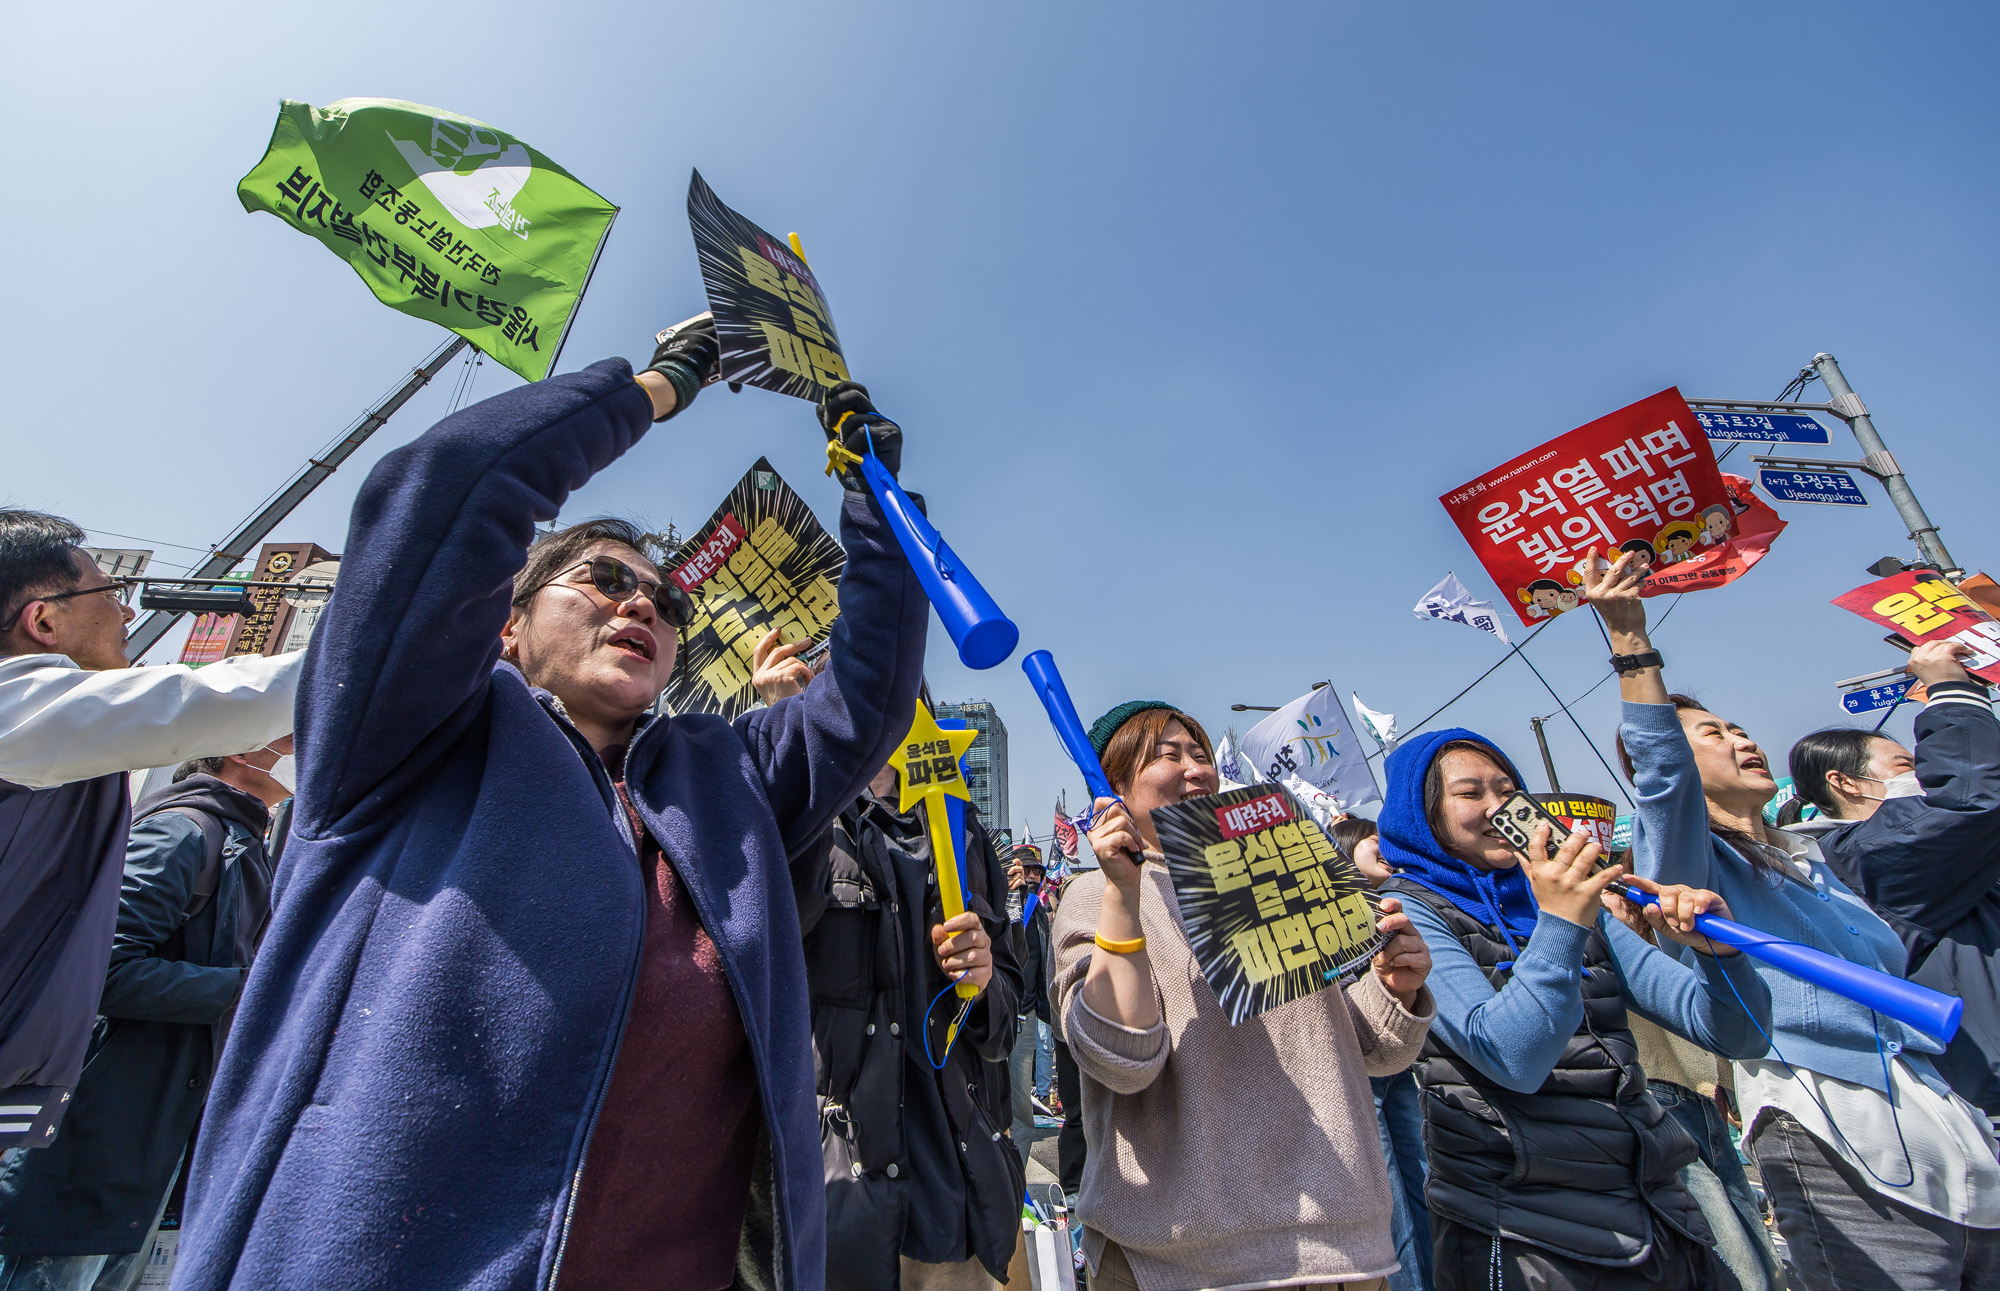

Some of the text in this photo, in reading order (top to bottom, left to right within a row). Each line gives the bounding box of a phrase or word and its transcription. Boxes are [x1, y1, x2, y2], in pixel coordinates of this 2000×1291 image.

[450, 339, 464, 354] KATO
[1697, 413, 1775, 430] 율곡로3길
[1704, 428, 1790, 441] Yulgok-ro 3-gil
[1449, 450, 1558, 505] 나눔문화 www.nanum.com
[1478, 420, 1698, 546] 윤석열 파면
[1793, 473, 1855, 491] 우정국로
[1783, 488, 1863, 503] Ujeongguk-ro
[1516, 469, 1696, 575] 빛의 혁명
[678, 523, 738, 586] 내란수괴
[1658, 572, 1699, 585] 이제그만
[1699, 566, 1738, 579] 공동투쟁
[238, 576, 273, 655] 대한불교조계
[1846, 699, 1859, 708] 29
[906, 738, 952, 760] 윤석열
[905, 755, 959, 787] 파면
[1224, 796, 1287, 832] 내란수괴
[1204, 819, 1338, 896] 윤석열을
[1232, 891, 1377, 986] 파면하라
